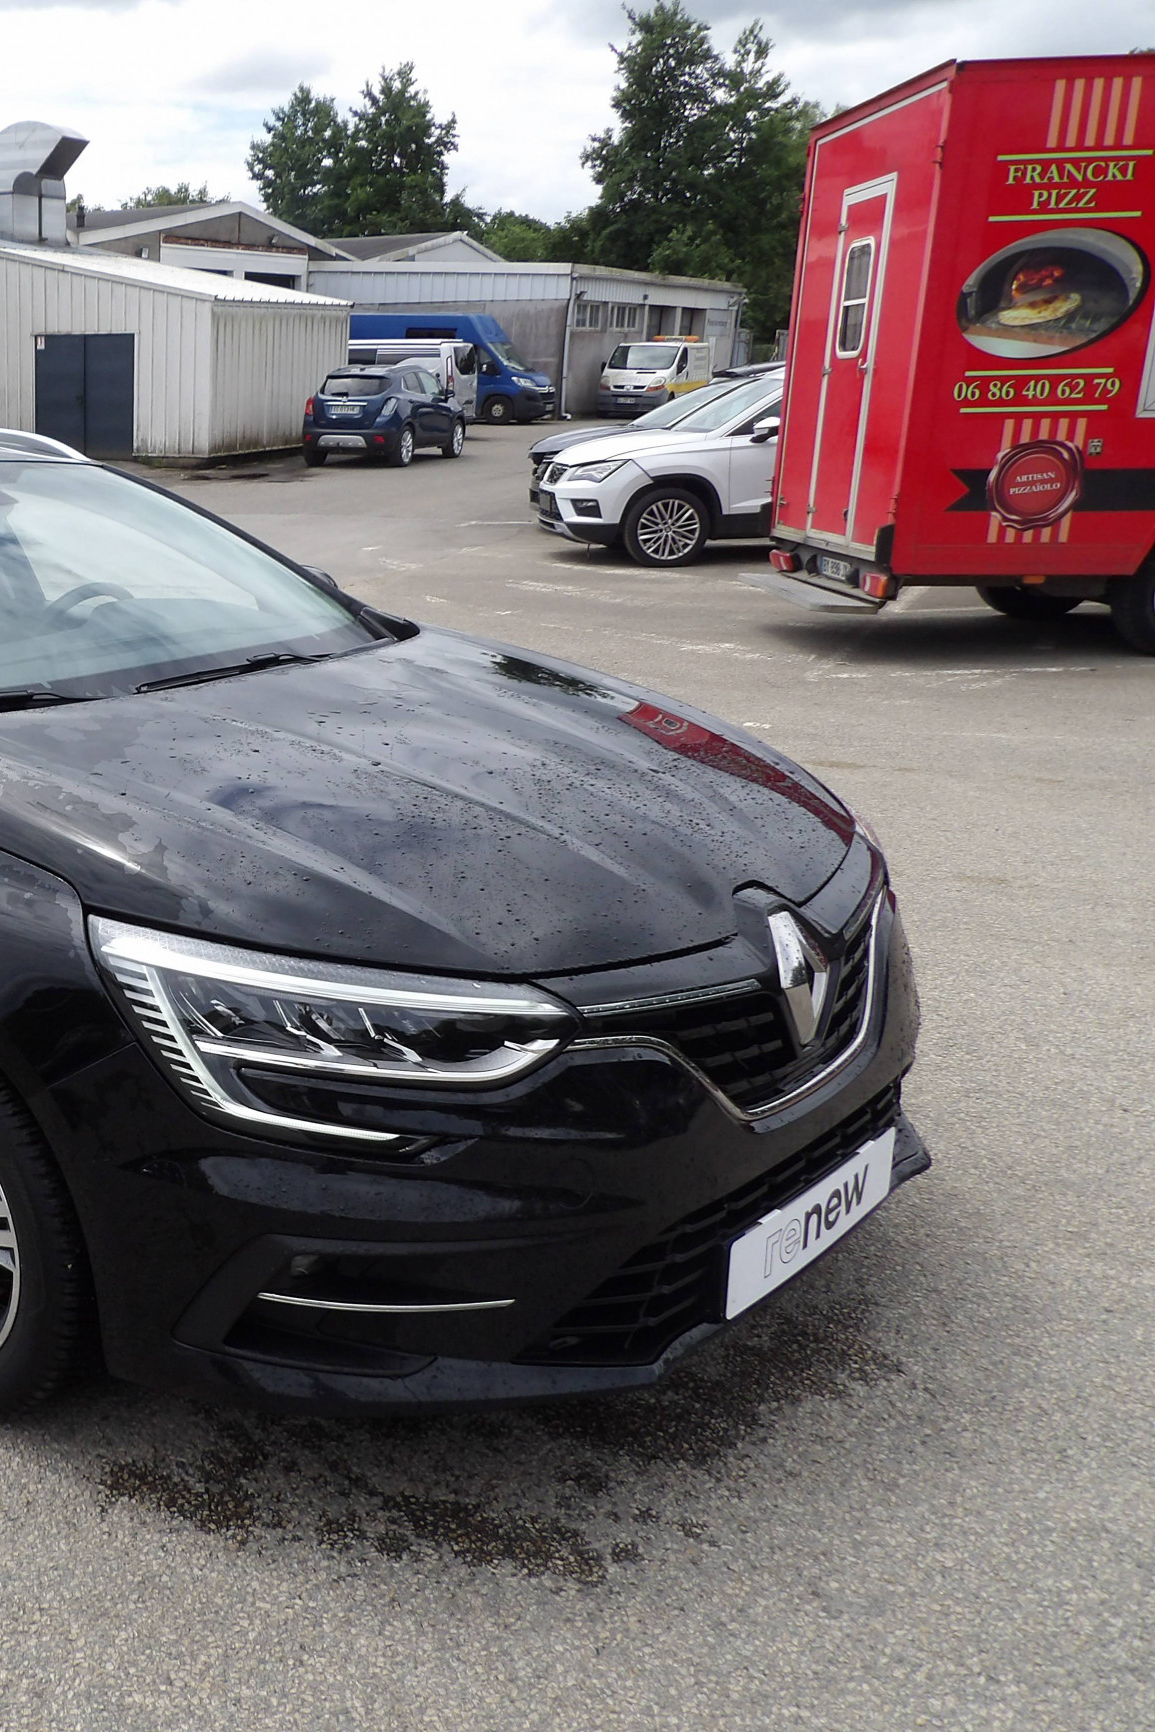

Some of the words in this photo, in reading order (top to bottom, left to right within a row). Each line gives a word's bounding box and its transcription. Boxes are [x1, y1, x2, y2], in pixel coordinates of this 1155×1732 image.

[1005, 161, 1137, 185] FRANCKI
[1030, 188, 1097, 210] PIZZ
[953, 381, 981, 401] 06
[987, 380, 1016, 400] 86
[1022, 379, 1050, 400] 40
[1056, 378, 1085, 399] 62
[1093, 377, 1121, 398] 79
[1015, 472, 1055, 482] ARTISAN
[764, 1163, 869, 1279] renew
